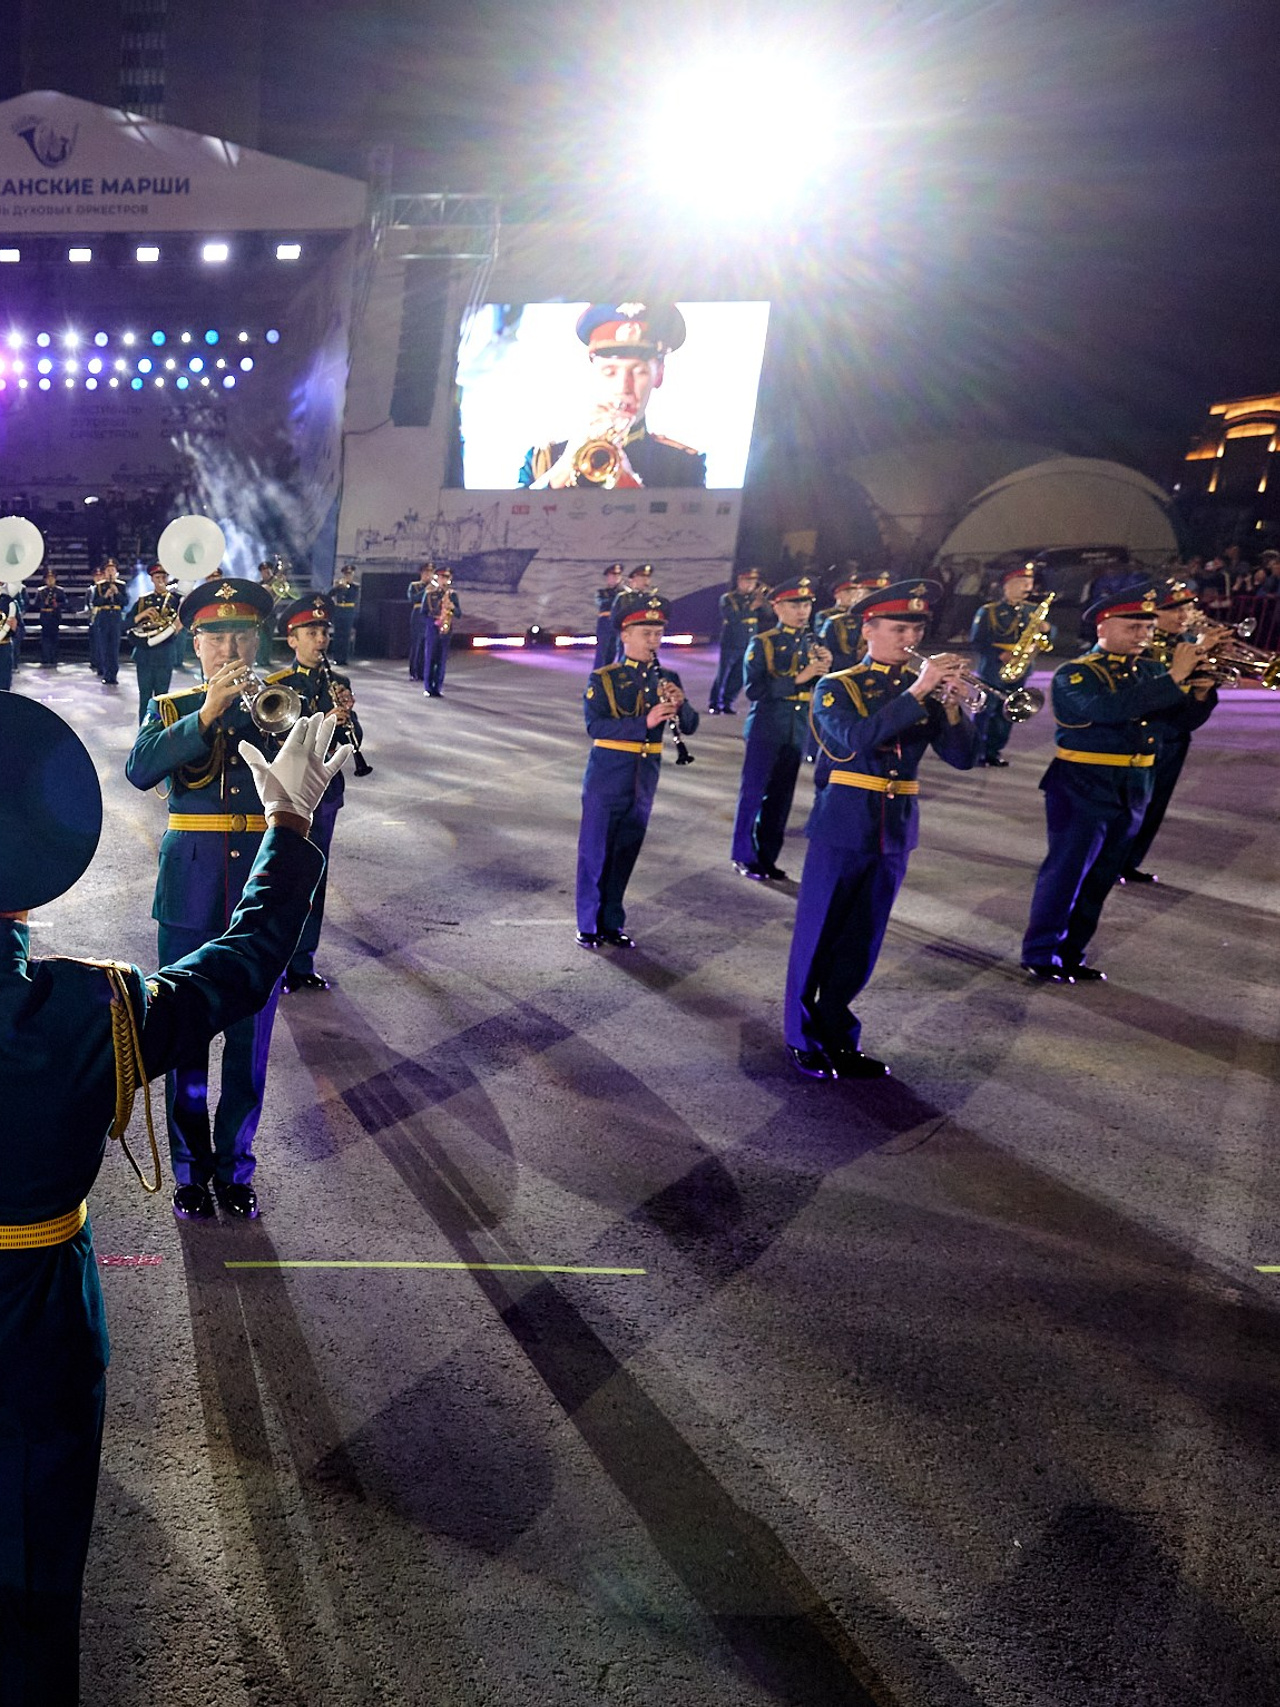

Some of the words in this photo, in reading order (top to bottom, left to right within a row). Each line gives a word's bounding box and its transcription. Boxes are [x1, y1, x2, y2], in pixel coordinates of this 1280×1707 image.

[101, 177, 190, 195] МАРШИ
[13, 204, 70, 217] ДУХОВЫХ
[76, 203, 149, 215] ОРКЕСТРОВ
